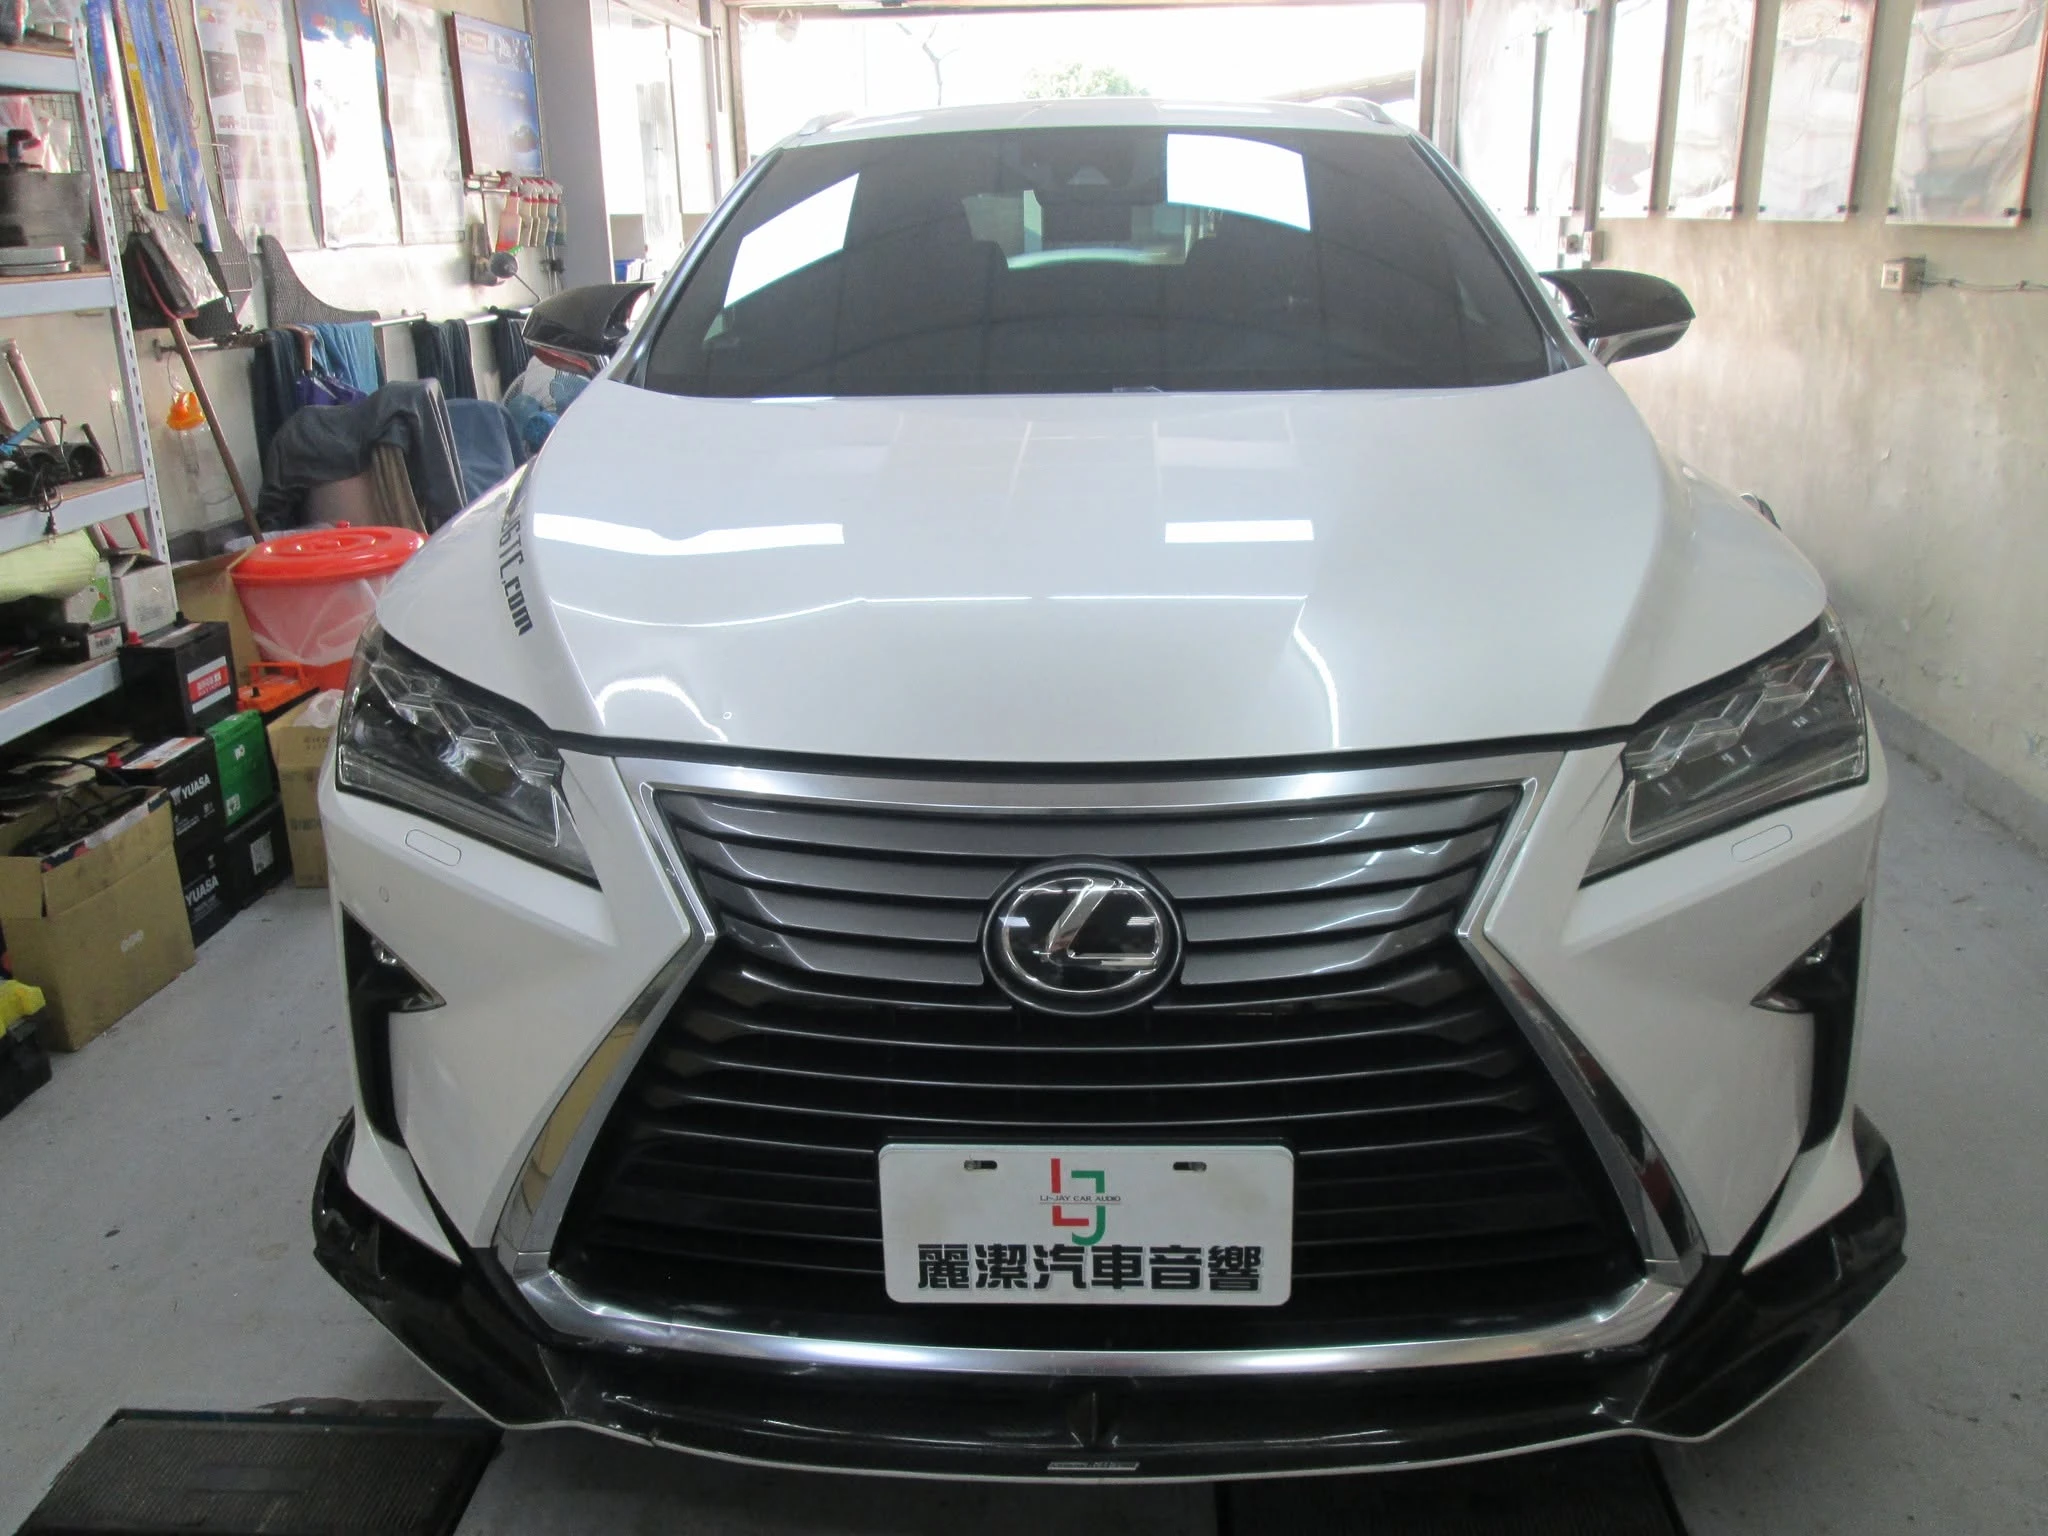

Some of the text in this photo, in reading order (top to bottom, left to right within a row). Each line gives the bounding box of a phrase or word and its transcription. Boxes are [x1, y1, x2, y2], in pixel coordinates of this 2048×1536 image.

[181, 773, 211, 799] YUASA
[185, 875, 219, 906] YUASA
[918, 1243, 1261, 1291] 麗潔汽車音響
